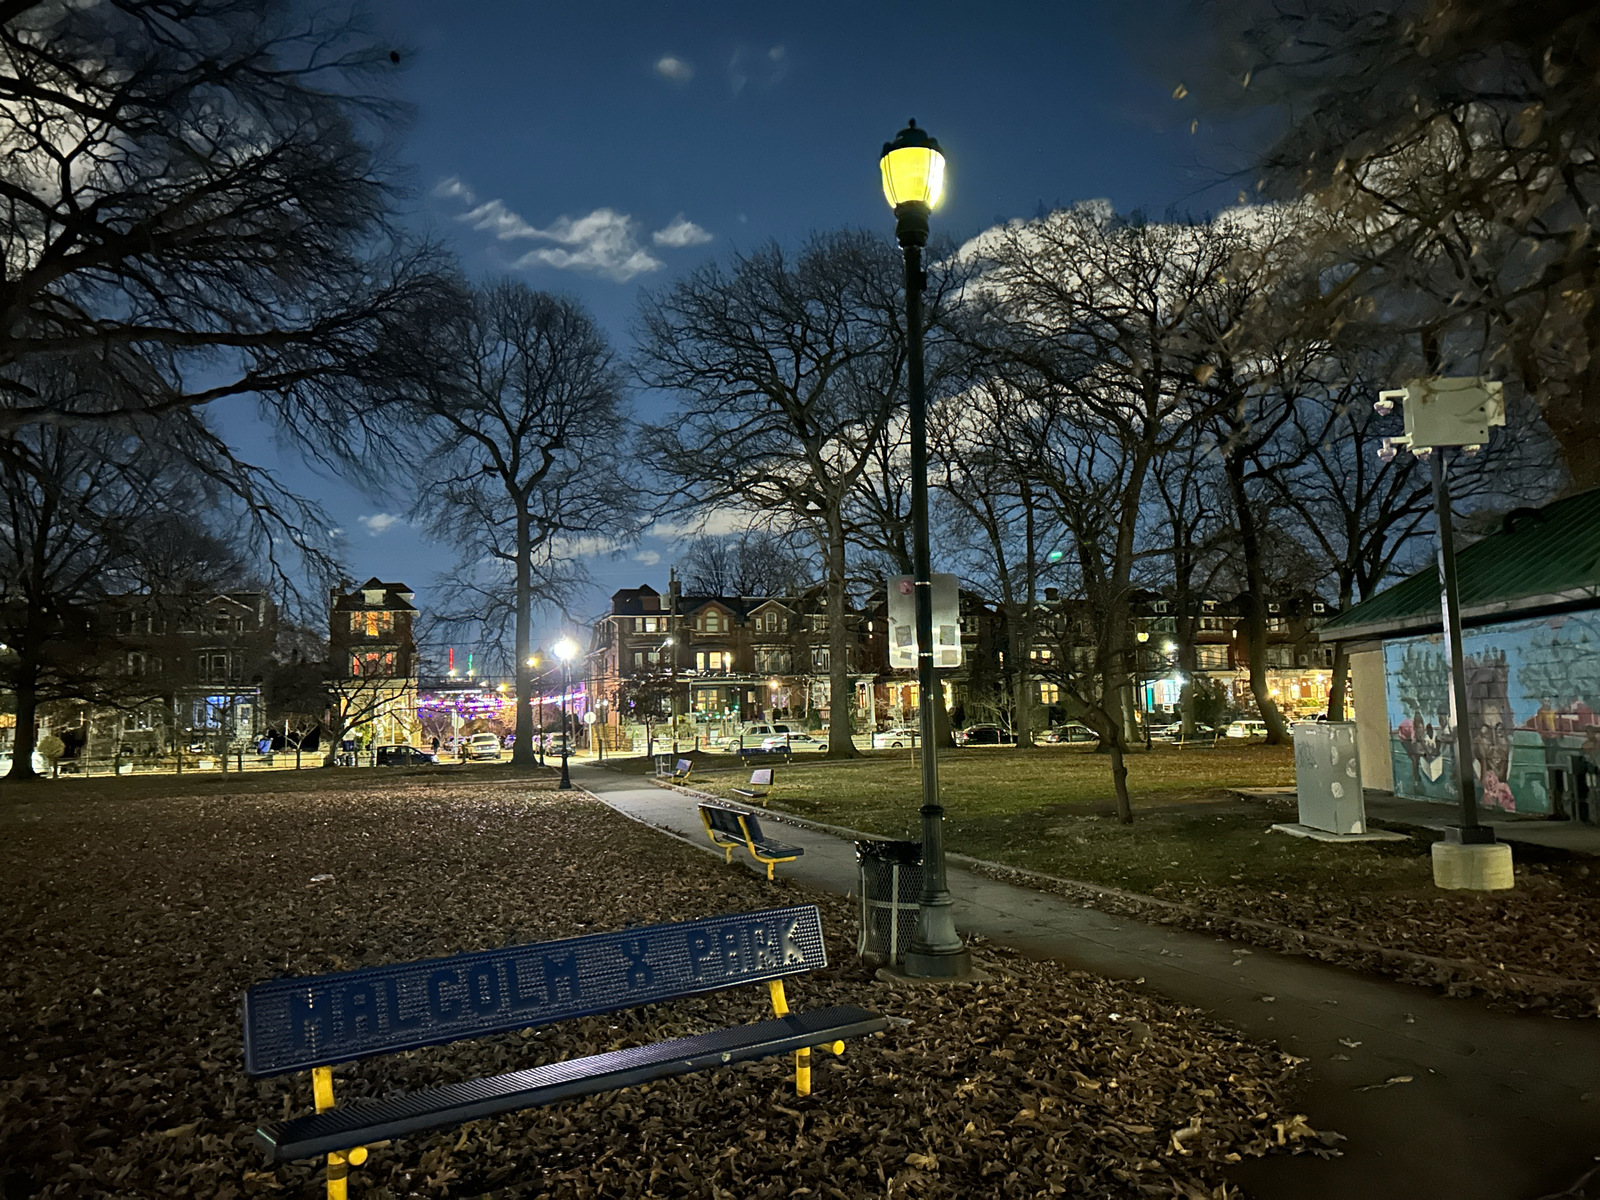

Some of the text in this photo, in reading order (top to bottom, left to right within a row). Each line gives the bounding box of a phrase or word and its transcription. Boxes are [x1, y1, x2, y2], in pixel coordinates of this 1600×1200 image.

[291, 917, 804, 1055] MALCOLM X PARK
